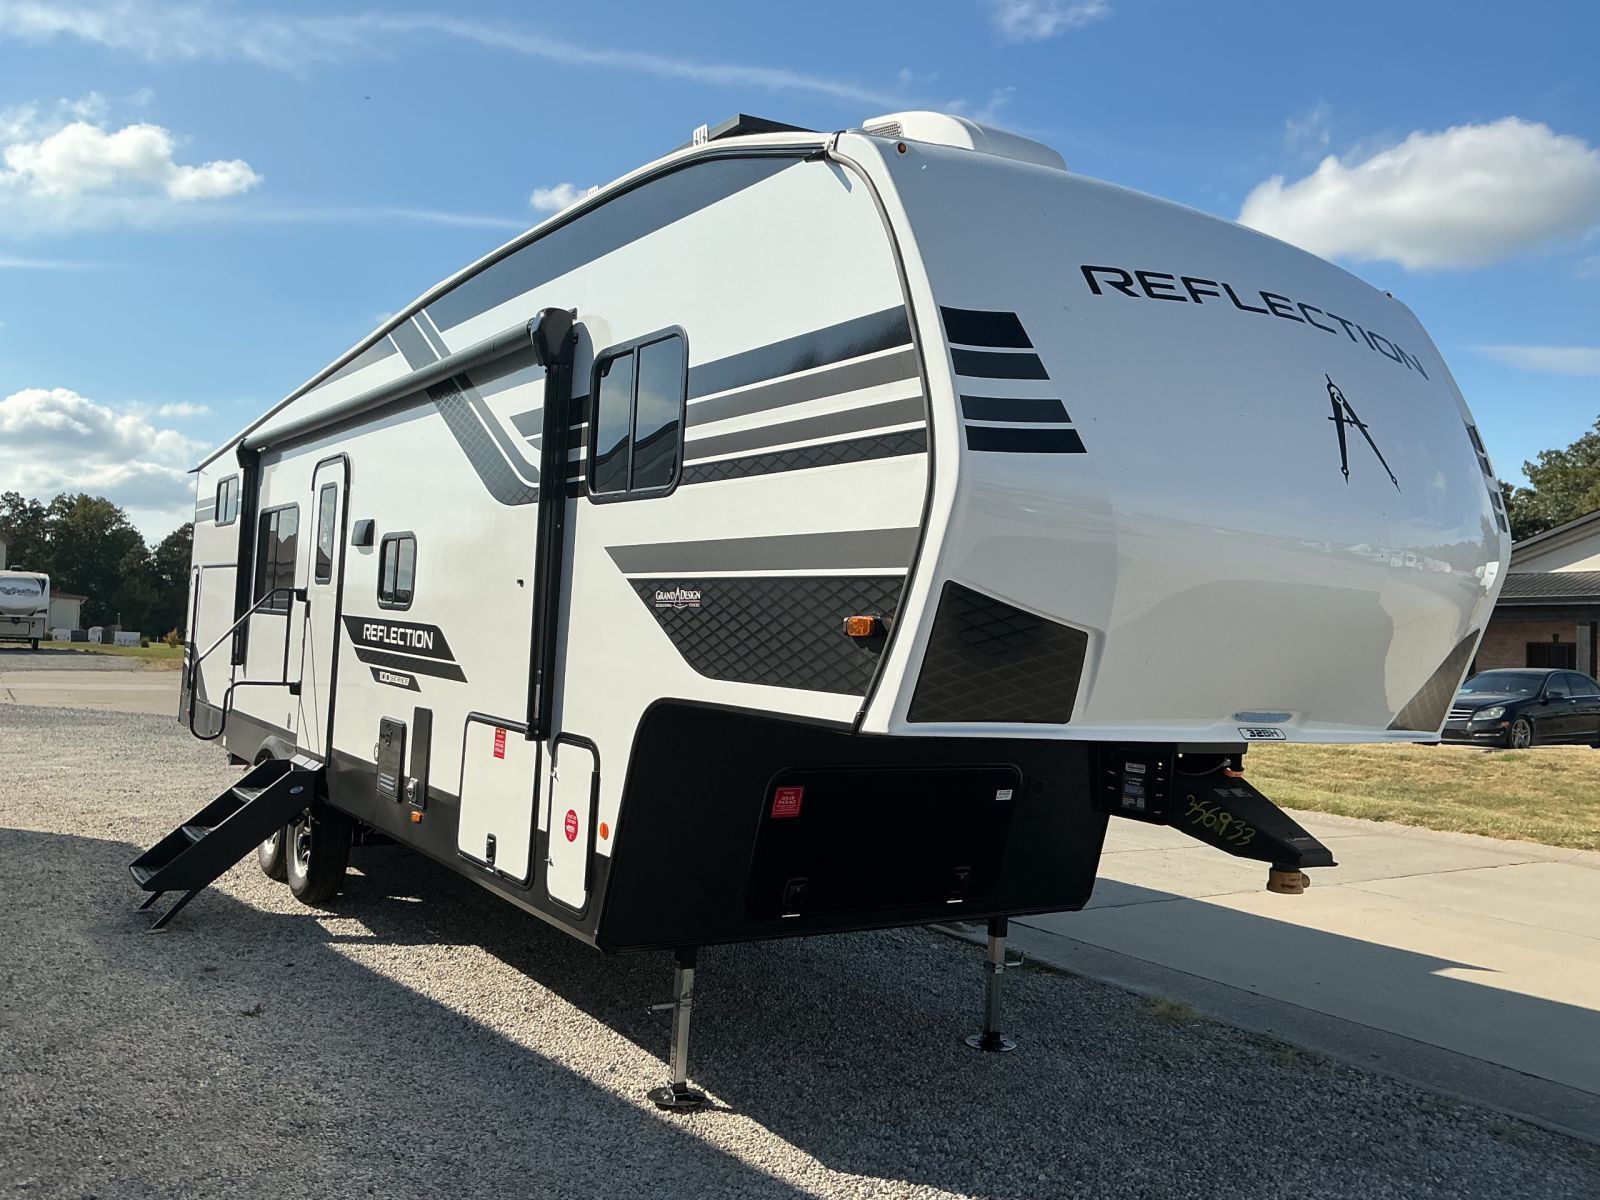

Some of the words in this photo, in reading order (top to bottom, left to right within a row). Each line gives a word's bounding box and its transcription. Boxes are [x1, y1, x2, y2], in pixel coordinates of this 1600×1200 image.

[1080, 265, 1430, 381] REFLECTION
[655, 590, 675, 600] GRAND
[680, 590, 701, 600] DESIGN
[362, 623, 434, 650] REFLECTION
[1246, 729, 1279, 737] 32BH
